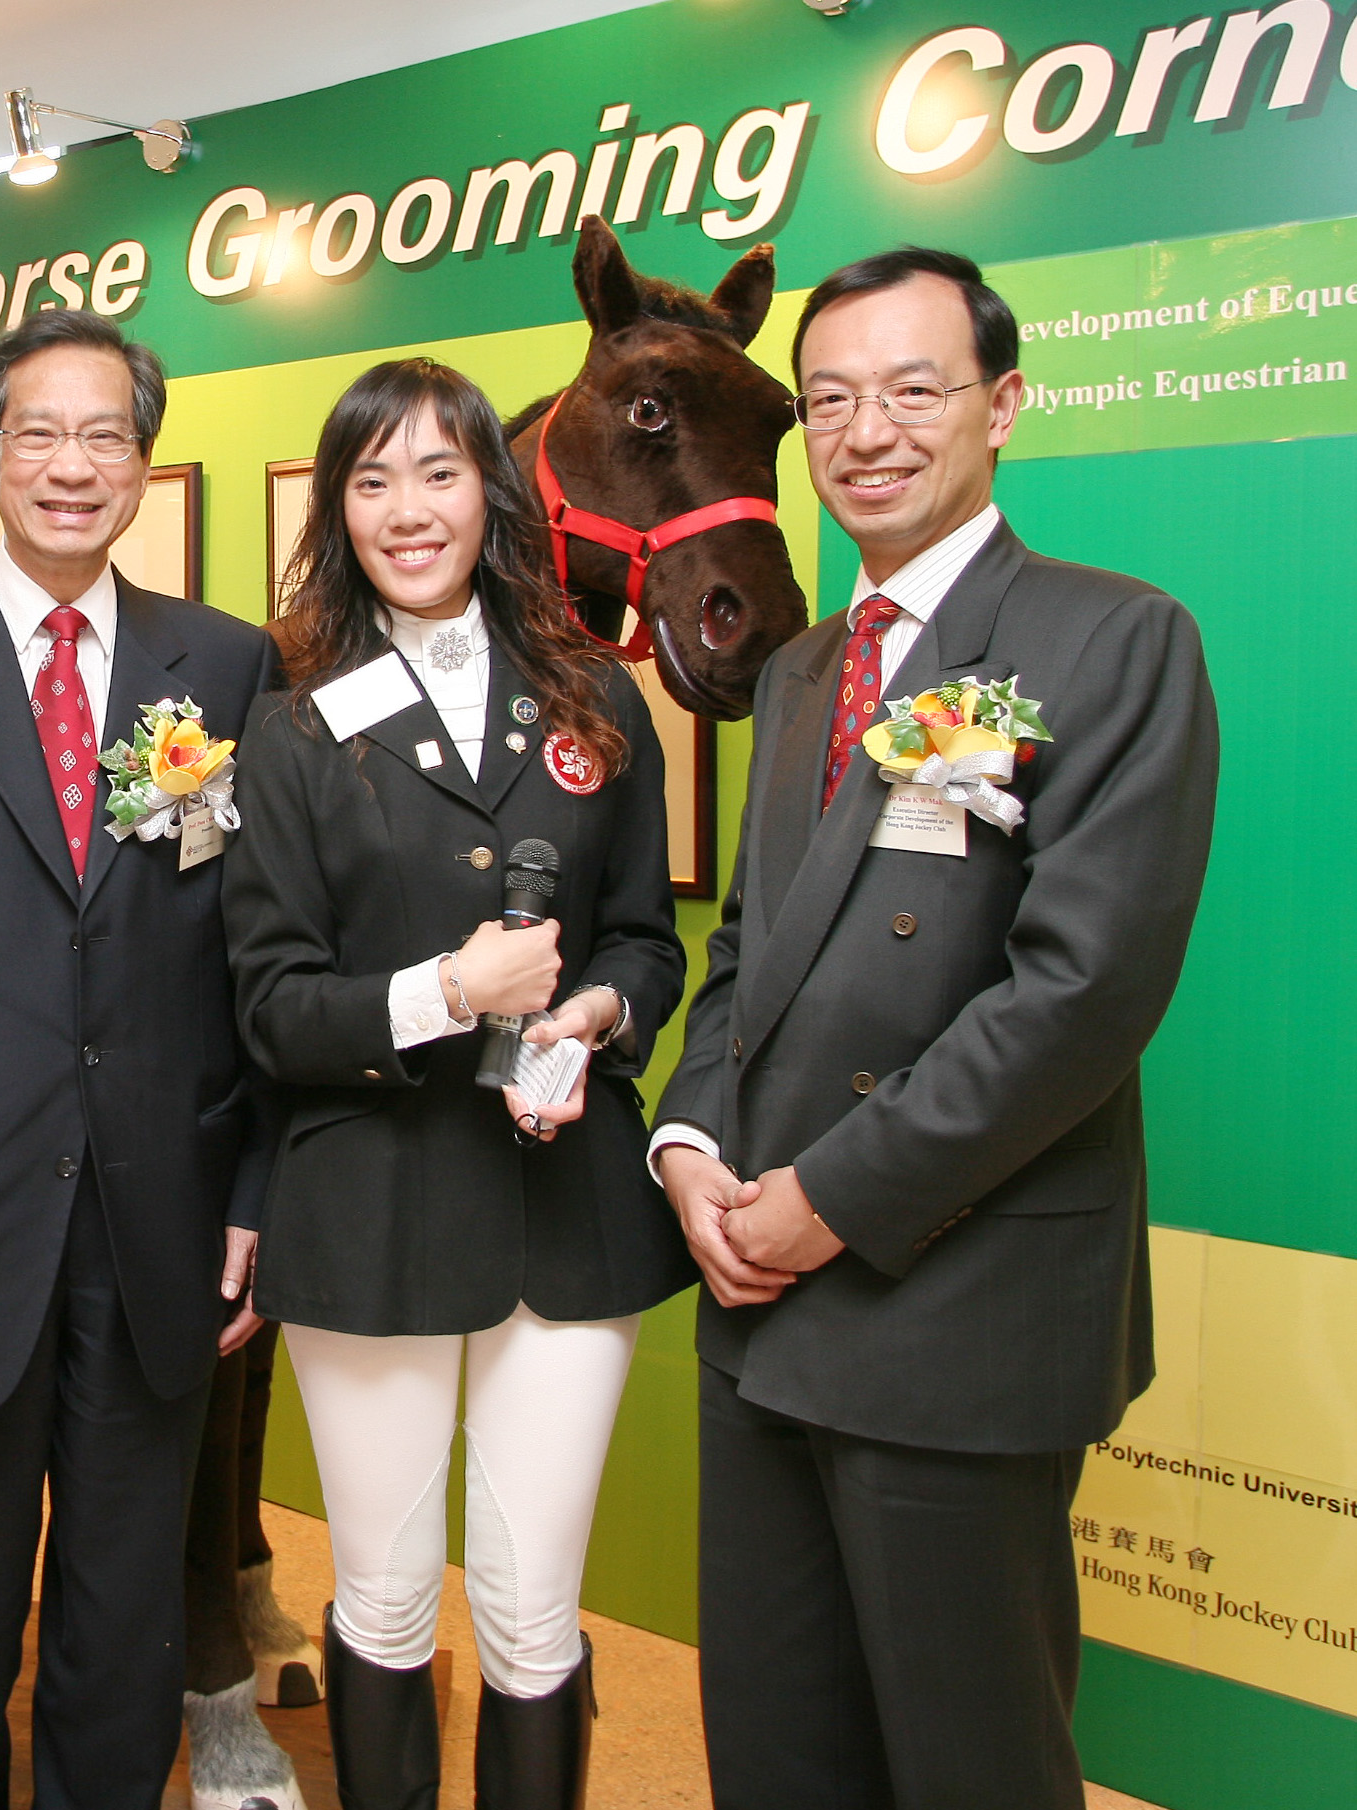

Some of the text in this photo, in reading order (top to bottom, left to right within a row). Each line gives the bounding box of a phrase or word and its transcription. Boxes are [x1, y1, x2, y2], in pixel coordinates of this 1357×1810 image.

[187, 101, 810, 299] Grooming
[874, 0, 1357, 175] Corn
[1019, 296, 1210, 343] evelopment
[1220, 286, 1259, 319] of
[1153, 357, 1347, 402] Equestrian
[1095, 1440, 1235, 1487] Polytechnic
[1071, 1515, 1216, 1574] 港賽馬會
[1081, 1555, 1142, 1597] Hong
[1147, 1573, 1208, 1616] Kong
[1211, 1591, 1299, 1640] Jockey
